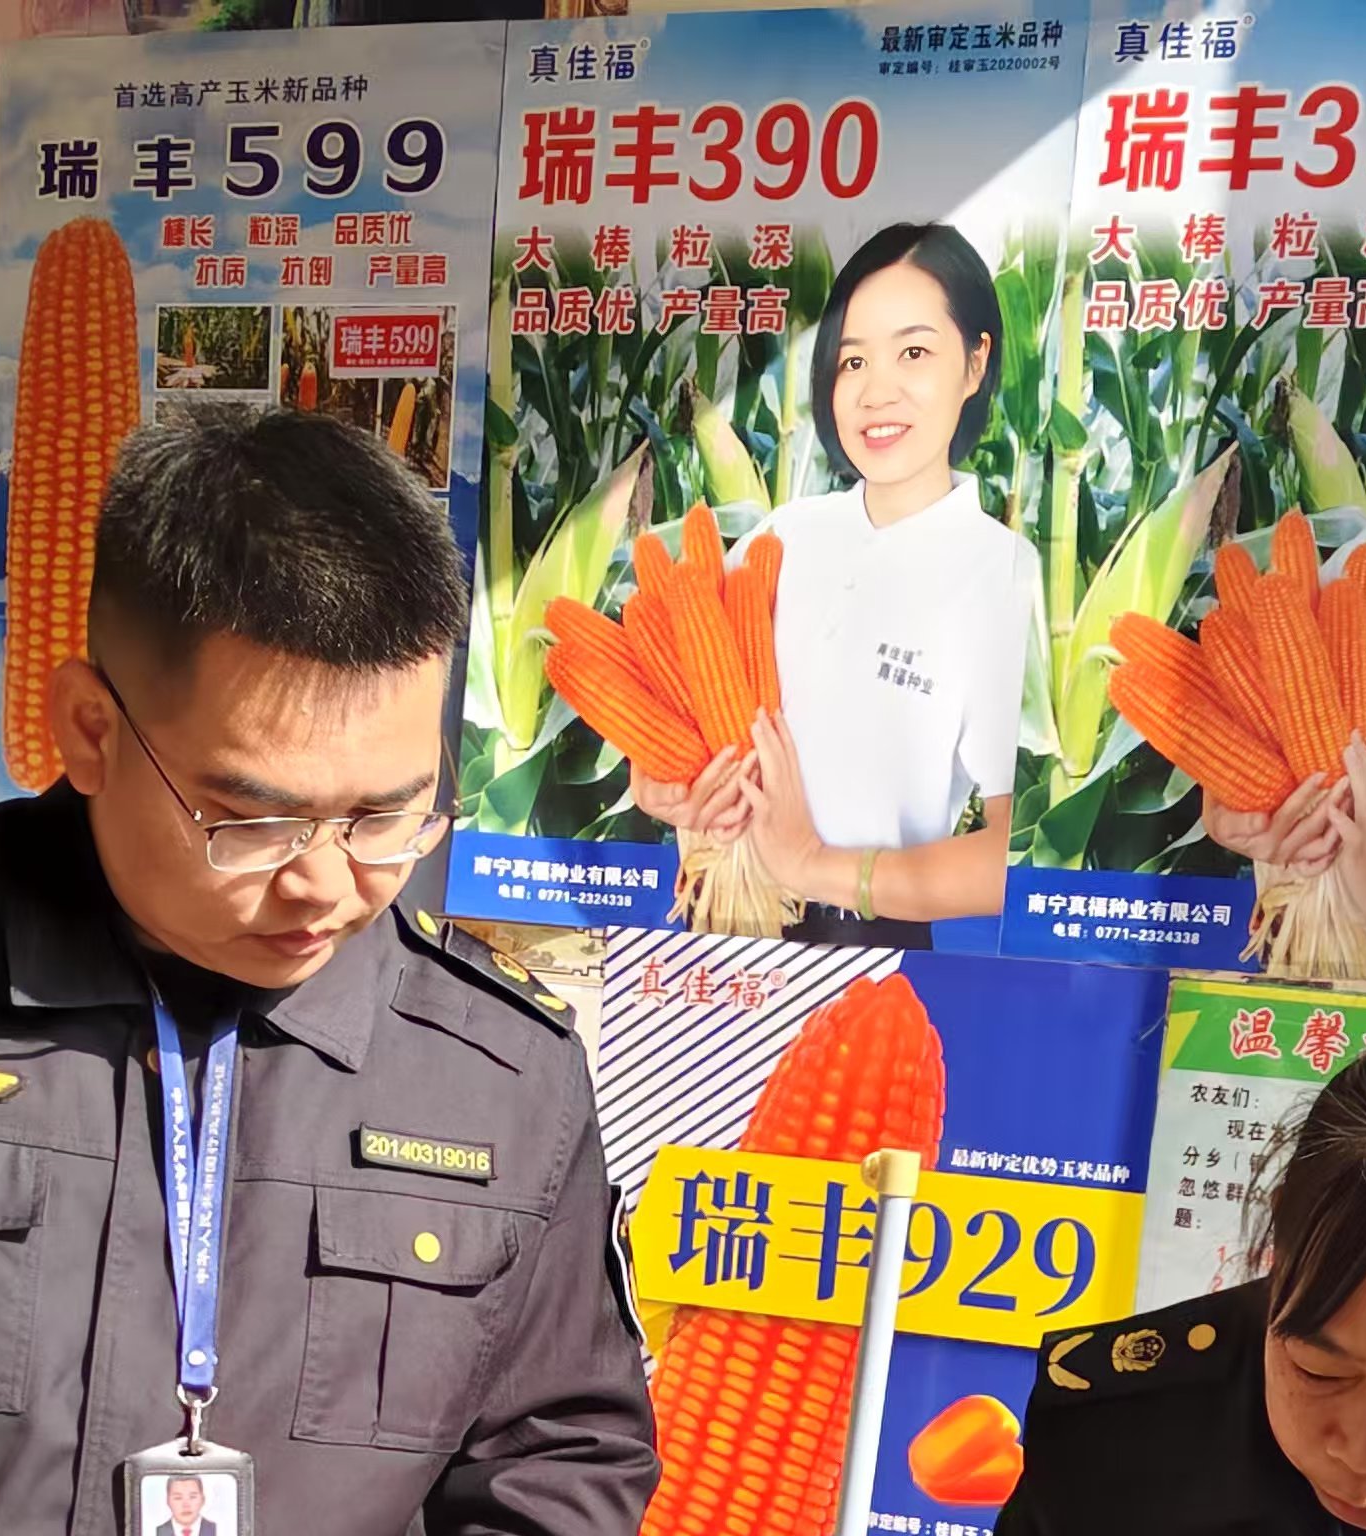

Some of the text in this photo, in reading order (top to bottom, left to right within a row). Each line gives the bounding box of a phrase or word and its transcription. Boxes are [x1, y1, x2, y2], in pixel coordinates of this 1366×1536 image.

[881, 20, 1064, 53] 最新审定玉米品种
[1114, 20, 1239, 63] 真佳福
[528, 43, 638, 84] 真佳福
[114, 75, 369, 110] 首选高产玉米新品种
[518, 100, 879, 205] 瑞丰390
[162, 213, 414, 248] 棒长 粒深 品质优
[195, 254, 447, 287] 抗病 抗倒 产量高
[511, 287, 787, 336] 品质优 产量高
[1085, 280, 1227, 330] 品质优
[340, 324, 434, 356] 瑞丰599
[876, 667, 936, 697] 真福种业
[474, 855, 659, 891] 南宁真福种业有限公司
[1027, 891, 1232, 928] 南宁真福种业有限公司
[633, 955, 767, 1010] 真佳福
[366, 1135, 490, 1171] 20140319016
[950, 1147, 1131, 1185] 最新审定优势玉米品种
[668, 1169, 1096, 1317] 瑞丰929
